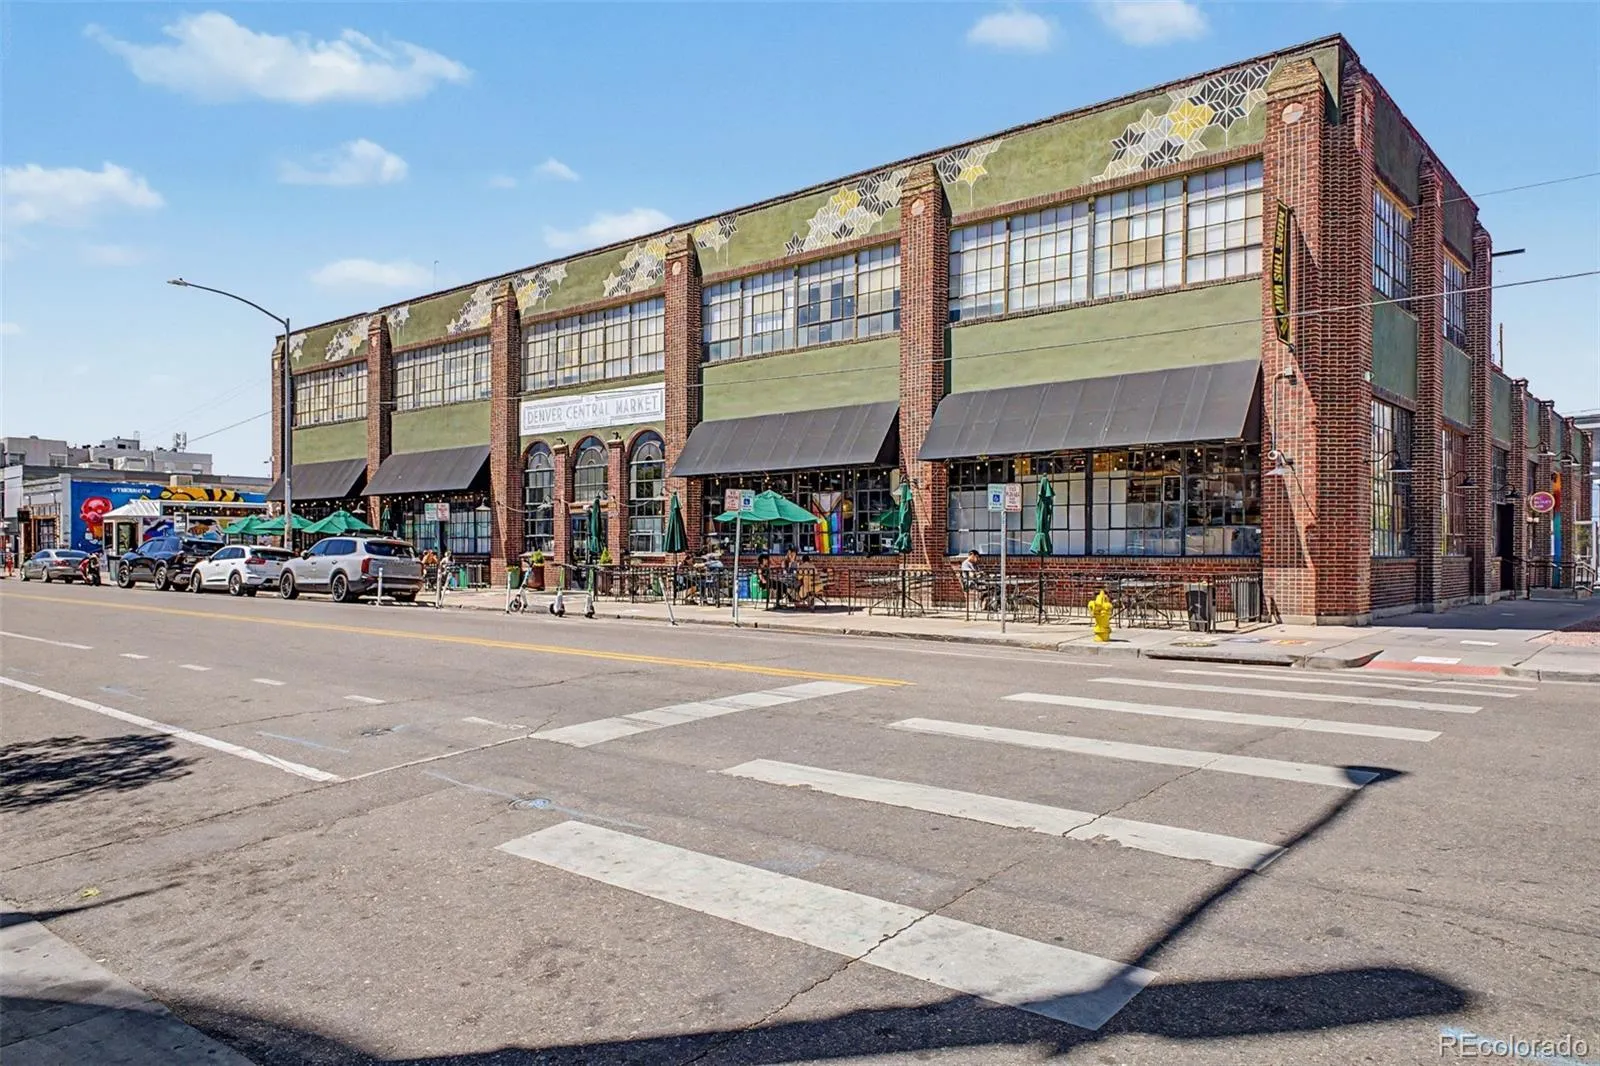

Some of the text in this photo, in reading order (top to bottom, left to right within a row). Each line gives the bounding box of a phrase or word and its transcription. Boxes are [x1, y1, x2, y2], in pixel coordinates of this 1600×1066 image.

[1273, 211, 1285, 314] MORE THIS WAY
[527, 407, 562, 424] DENVER
[566, 401, 610, 420] CENTRAL
[615, 395, 658, 414] MARKET
